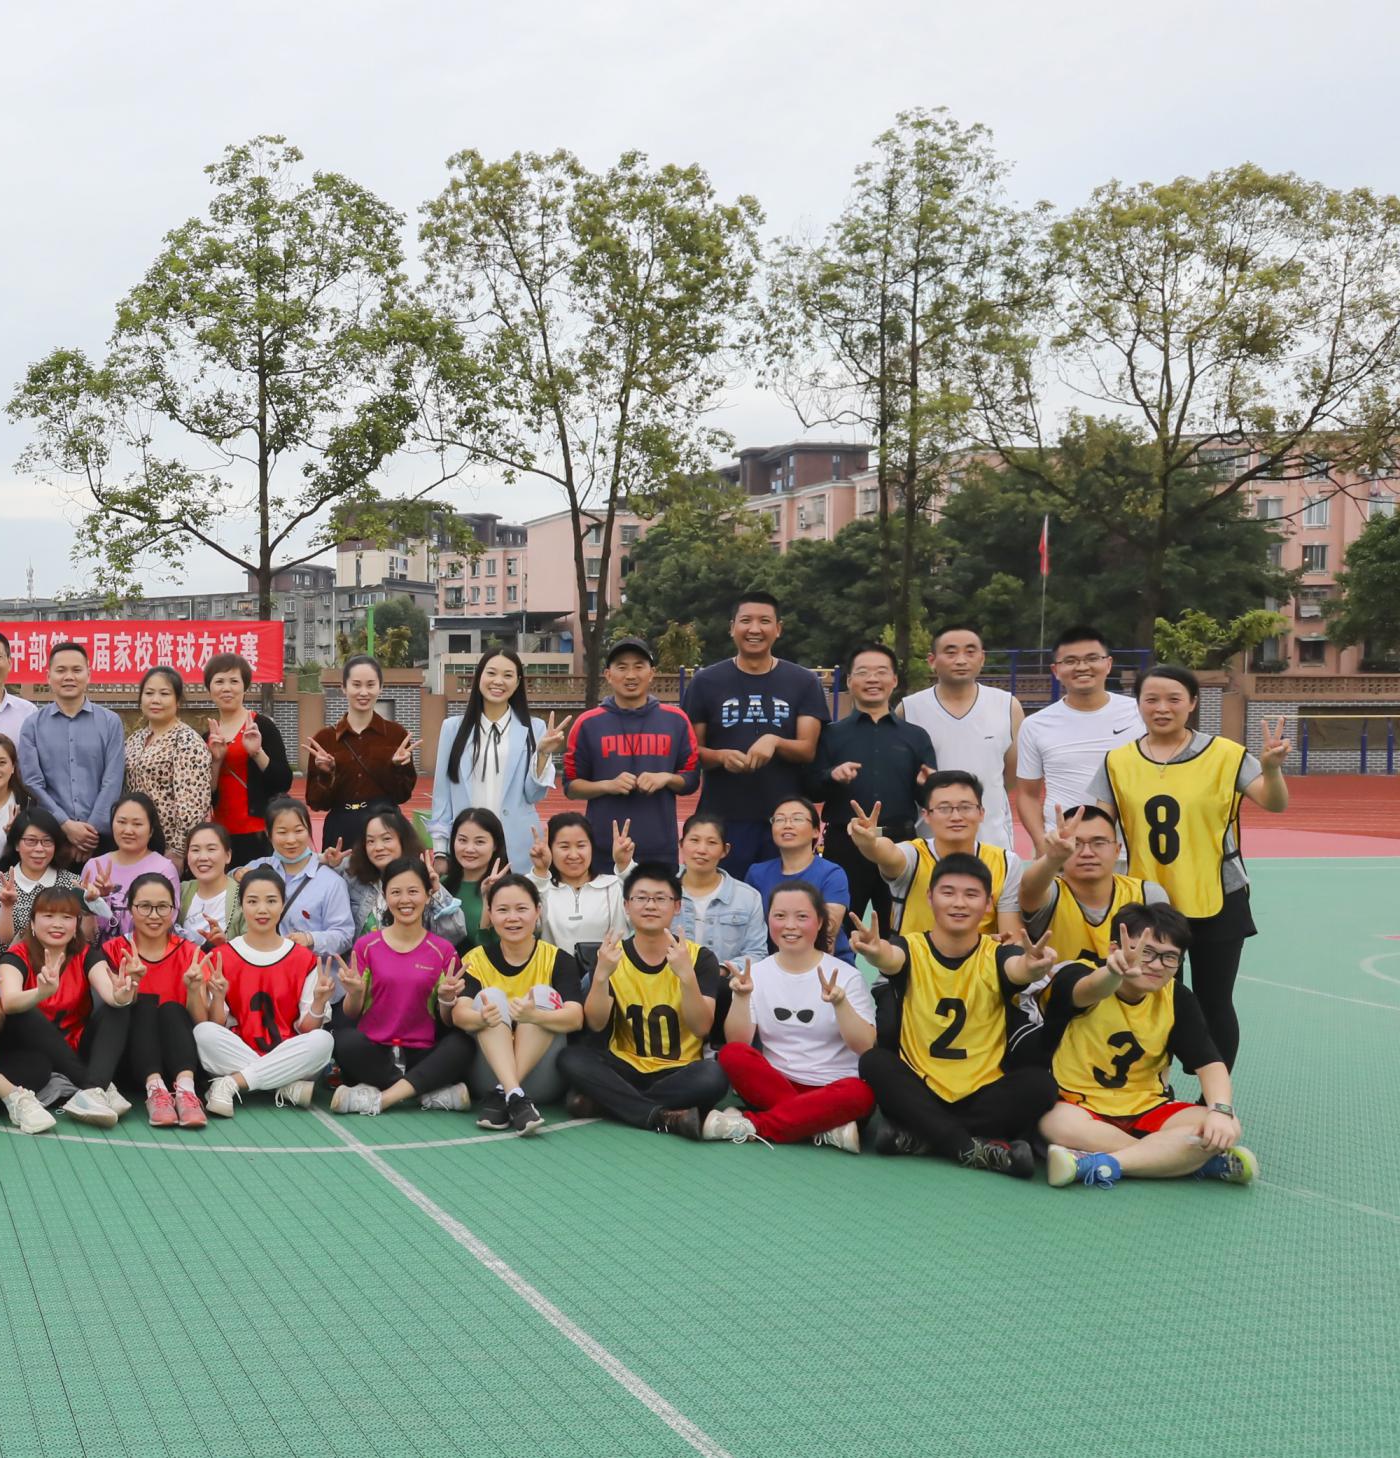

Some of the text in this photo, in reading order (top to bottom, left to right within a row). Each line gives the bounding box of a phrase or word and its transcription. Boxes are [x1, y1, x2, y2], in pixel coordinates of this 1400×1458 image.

[721, 694, 790, 728] GAP
[601, 733, 671, 758] PUMA
[1144, 793, 1181, 866] 8
[249, 991, 283, 1054] 3
[625, 1003, 682, 1061] 10
[929, 997, 968, 1060] 2
[1092, 1030, 1147, 1089] 3
